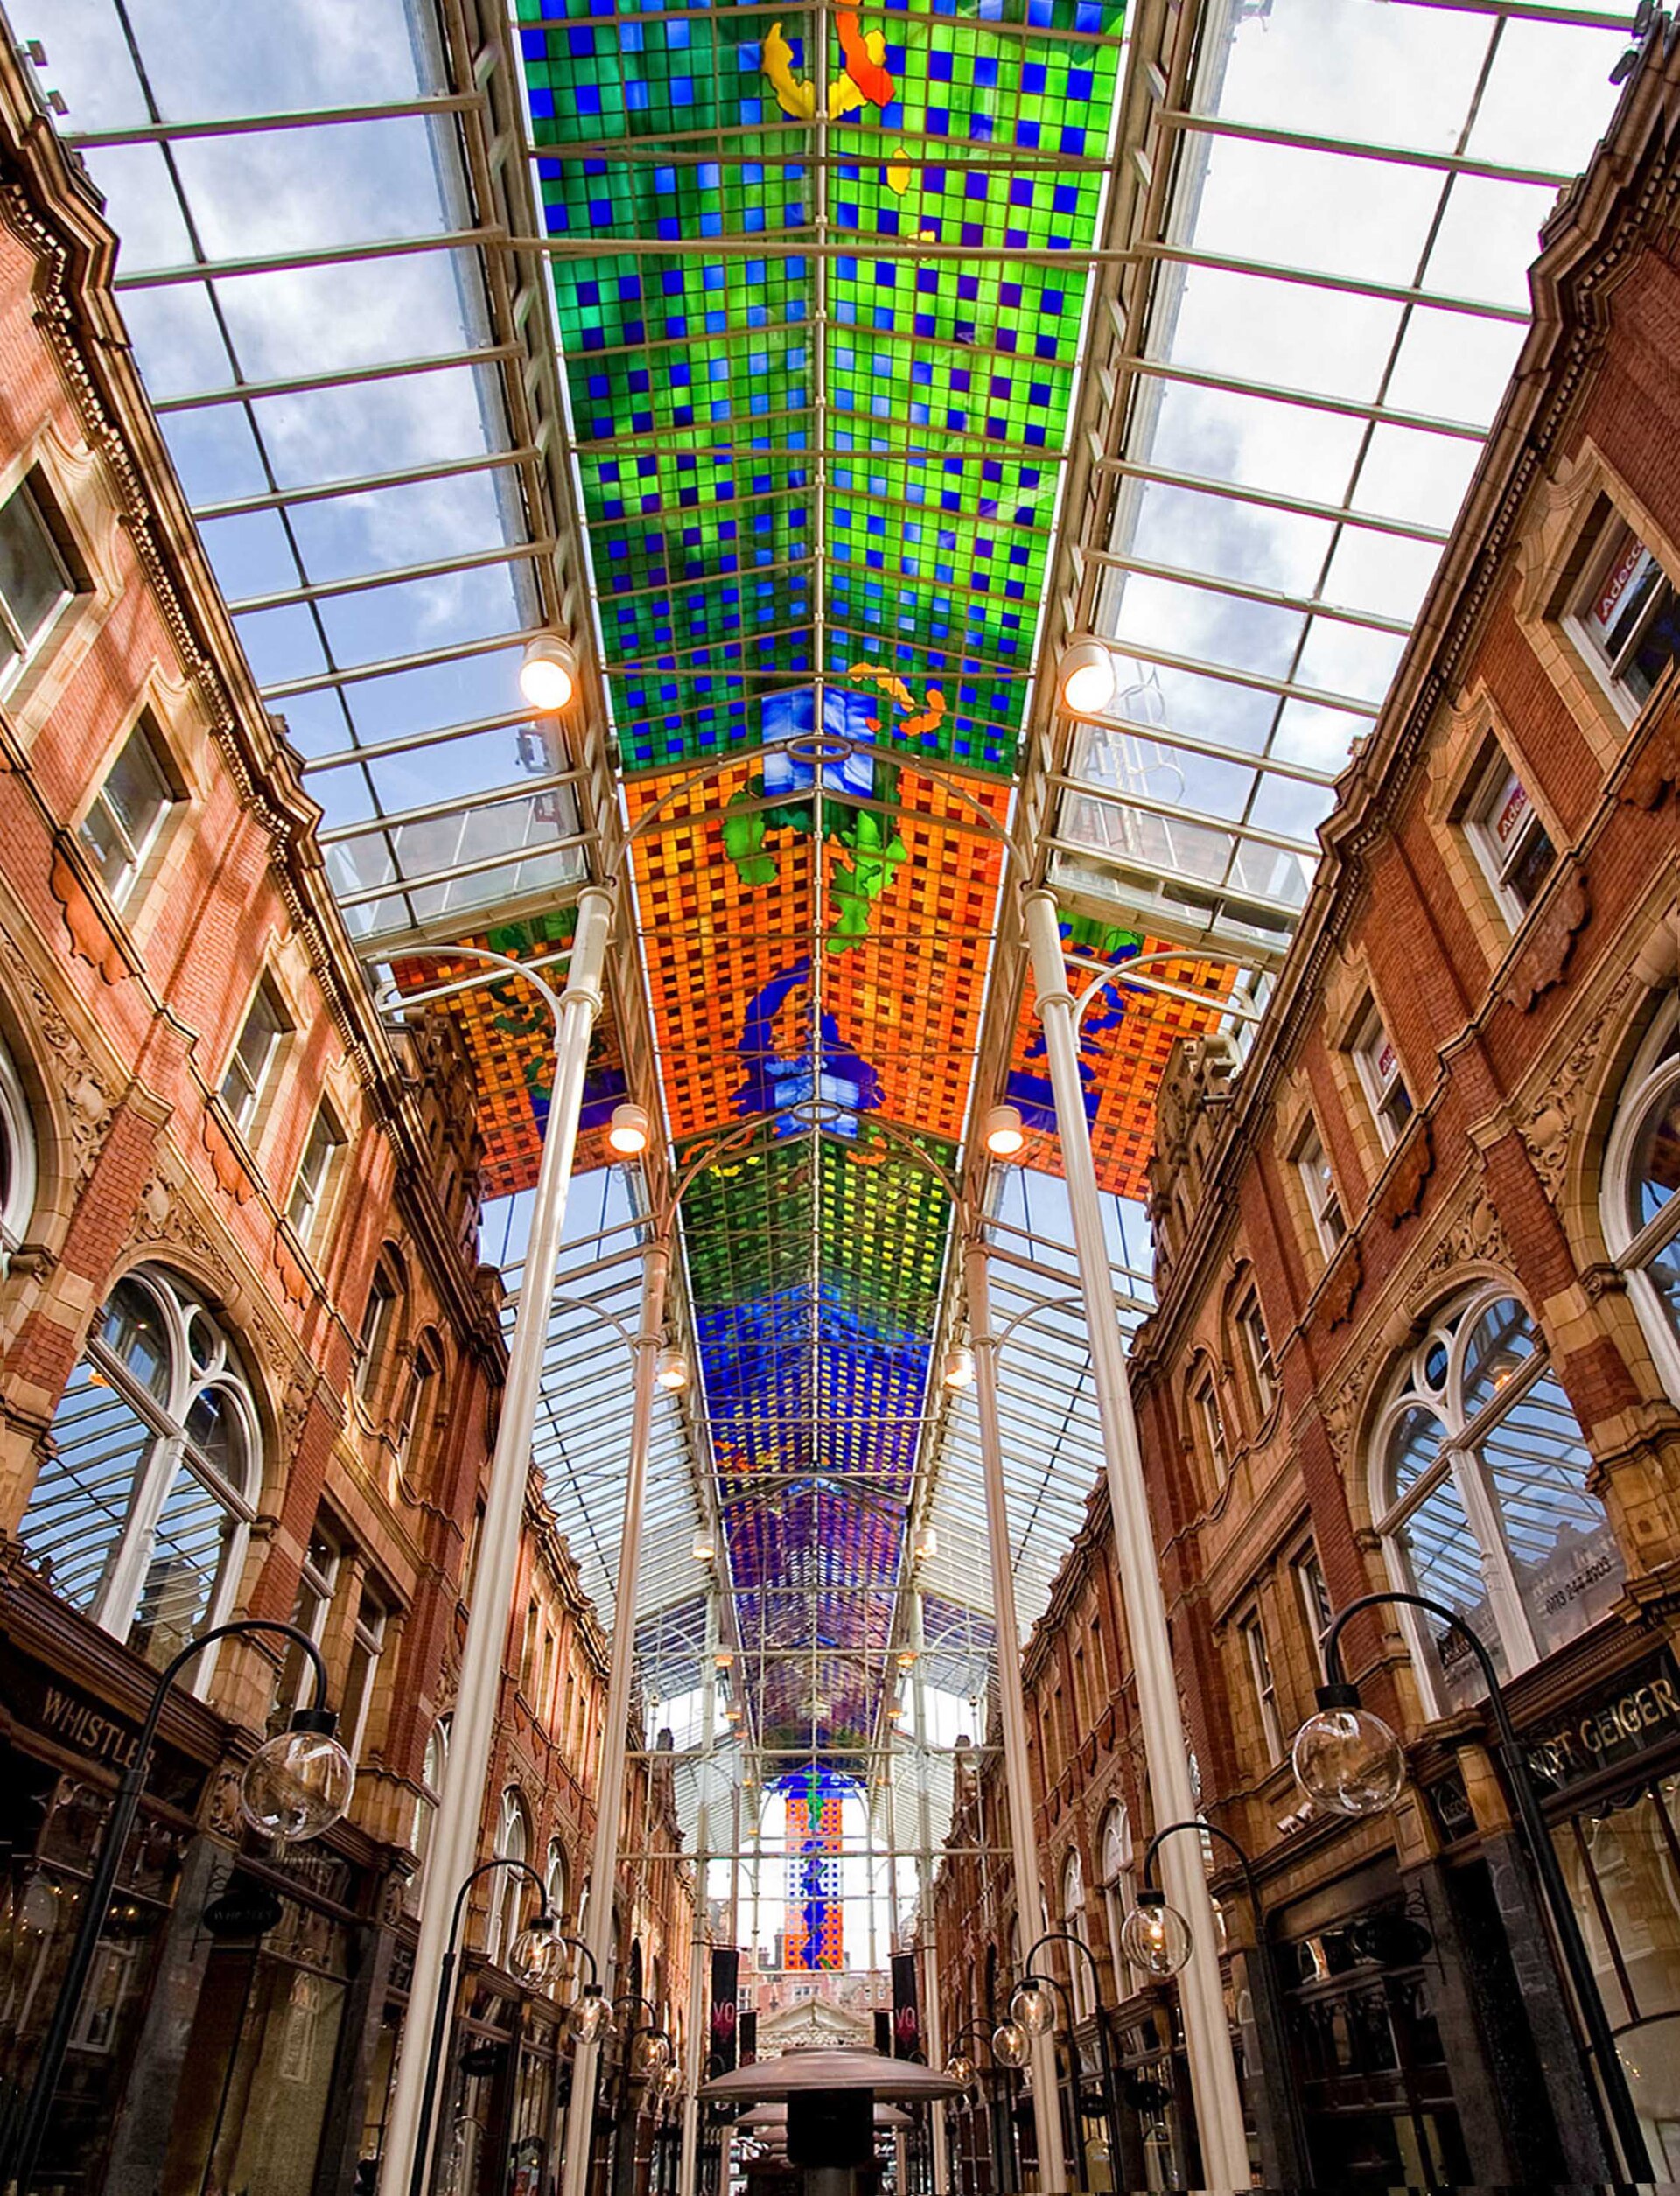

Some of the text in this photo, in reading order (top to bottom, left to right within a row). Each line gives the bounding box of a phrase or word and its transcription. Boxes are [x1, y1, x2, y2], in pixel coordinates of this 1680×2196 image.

[41, 1686, 158, 1773] WHISTLES
[1579, 1678, 1680, 1754] GEIGER
[895, 2006, 916, 2029] VQ
